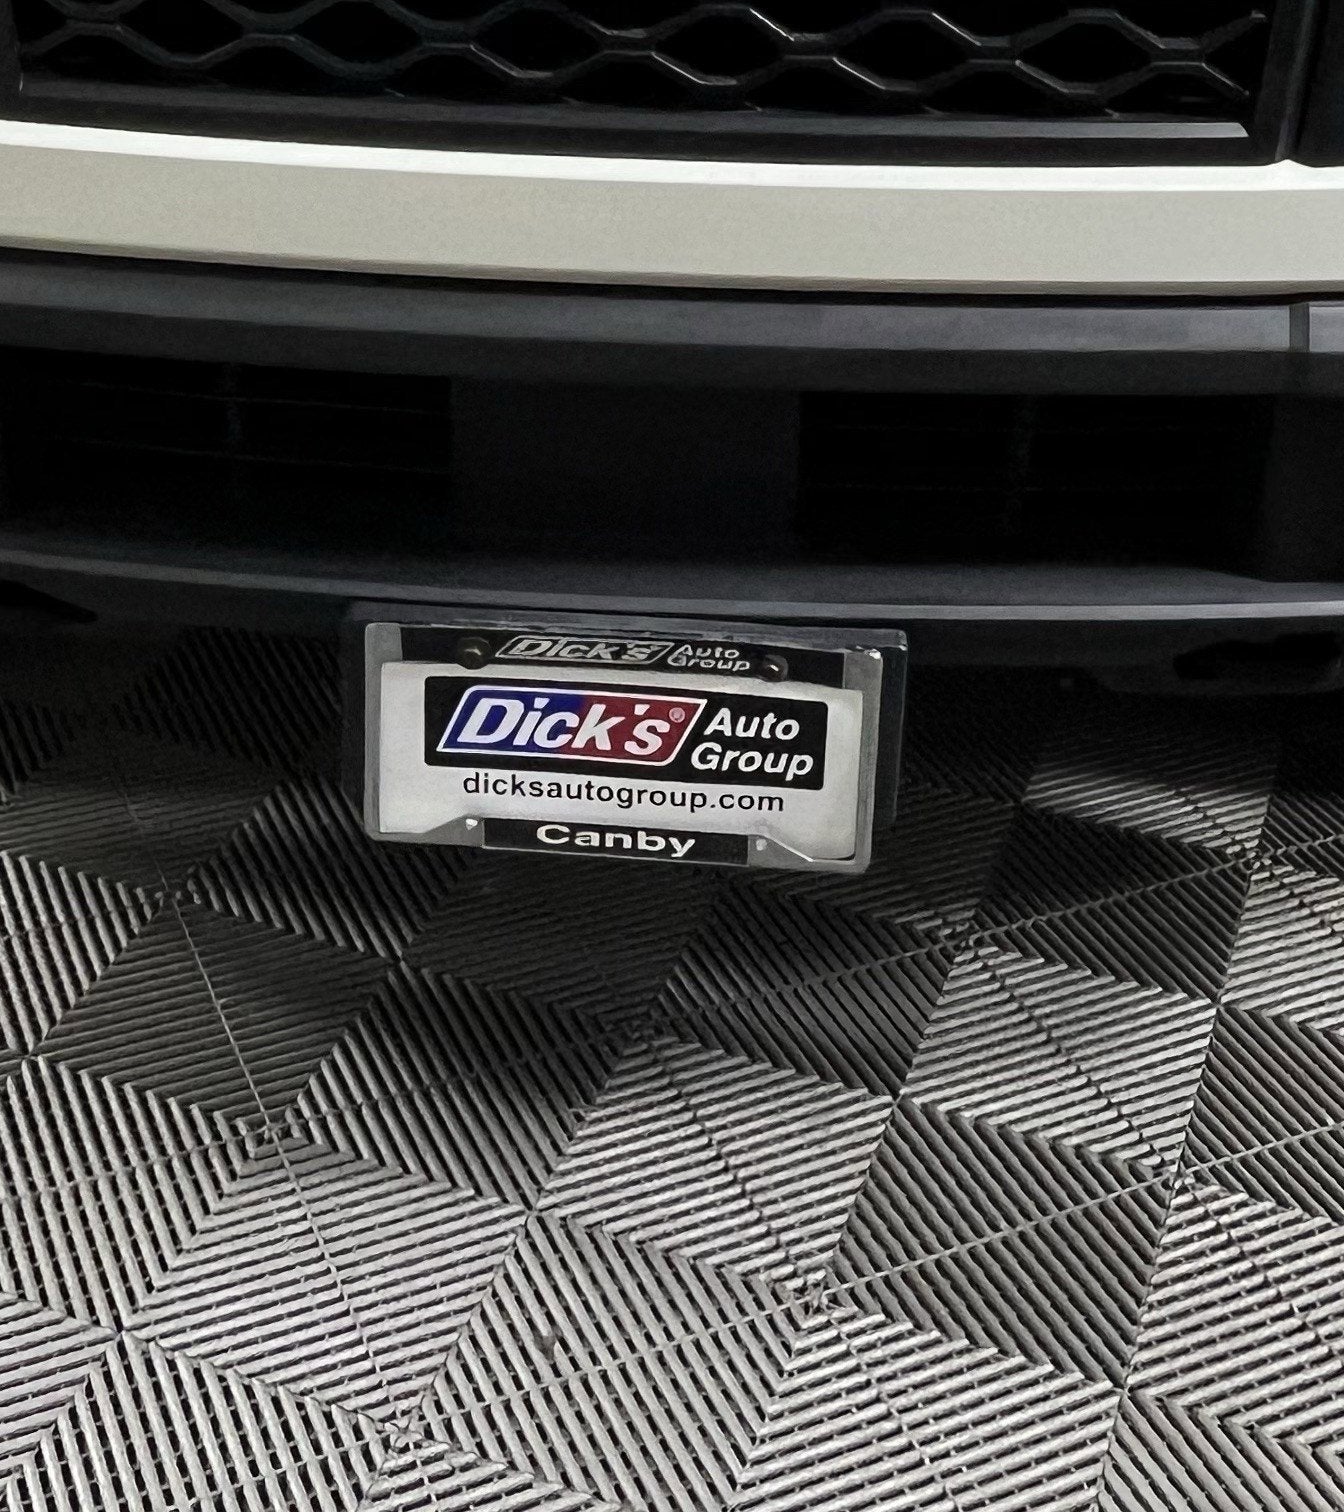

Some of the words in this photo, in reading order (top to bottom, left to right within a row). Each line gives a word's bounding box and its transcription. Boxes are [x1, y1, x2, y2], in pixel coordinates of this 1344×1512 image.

[667, 655, 751, 673] Group
[673, 644, 740, 659] Auto
[704, 706, 801, 742] Auto
[690, 743, 815, 781] Group
[462, 772, 785, 813] dicksautogroup.com
[535, 823, 696, 858] Canby
